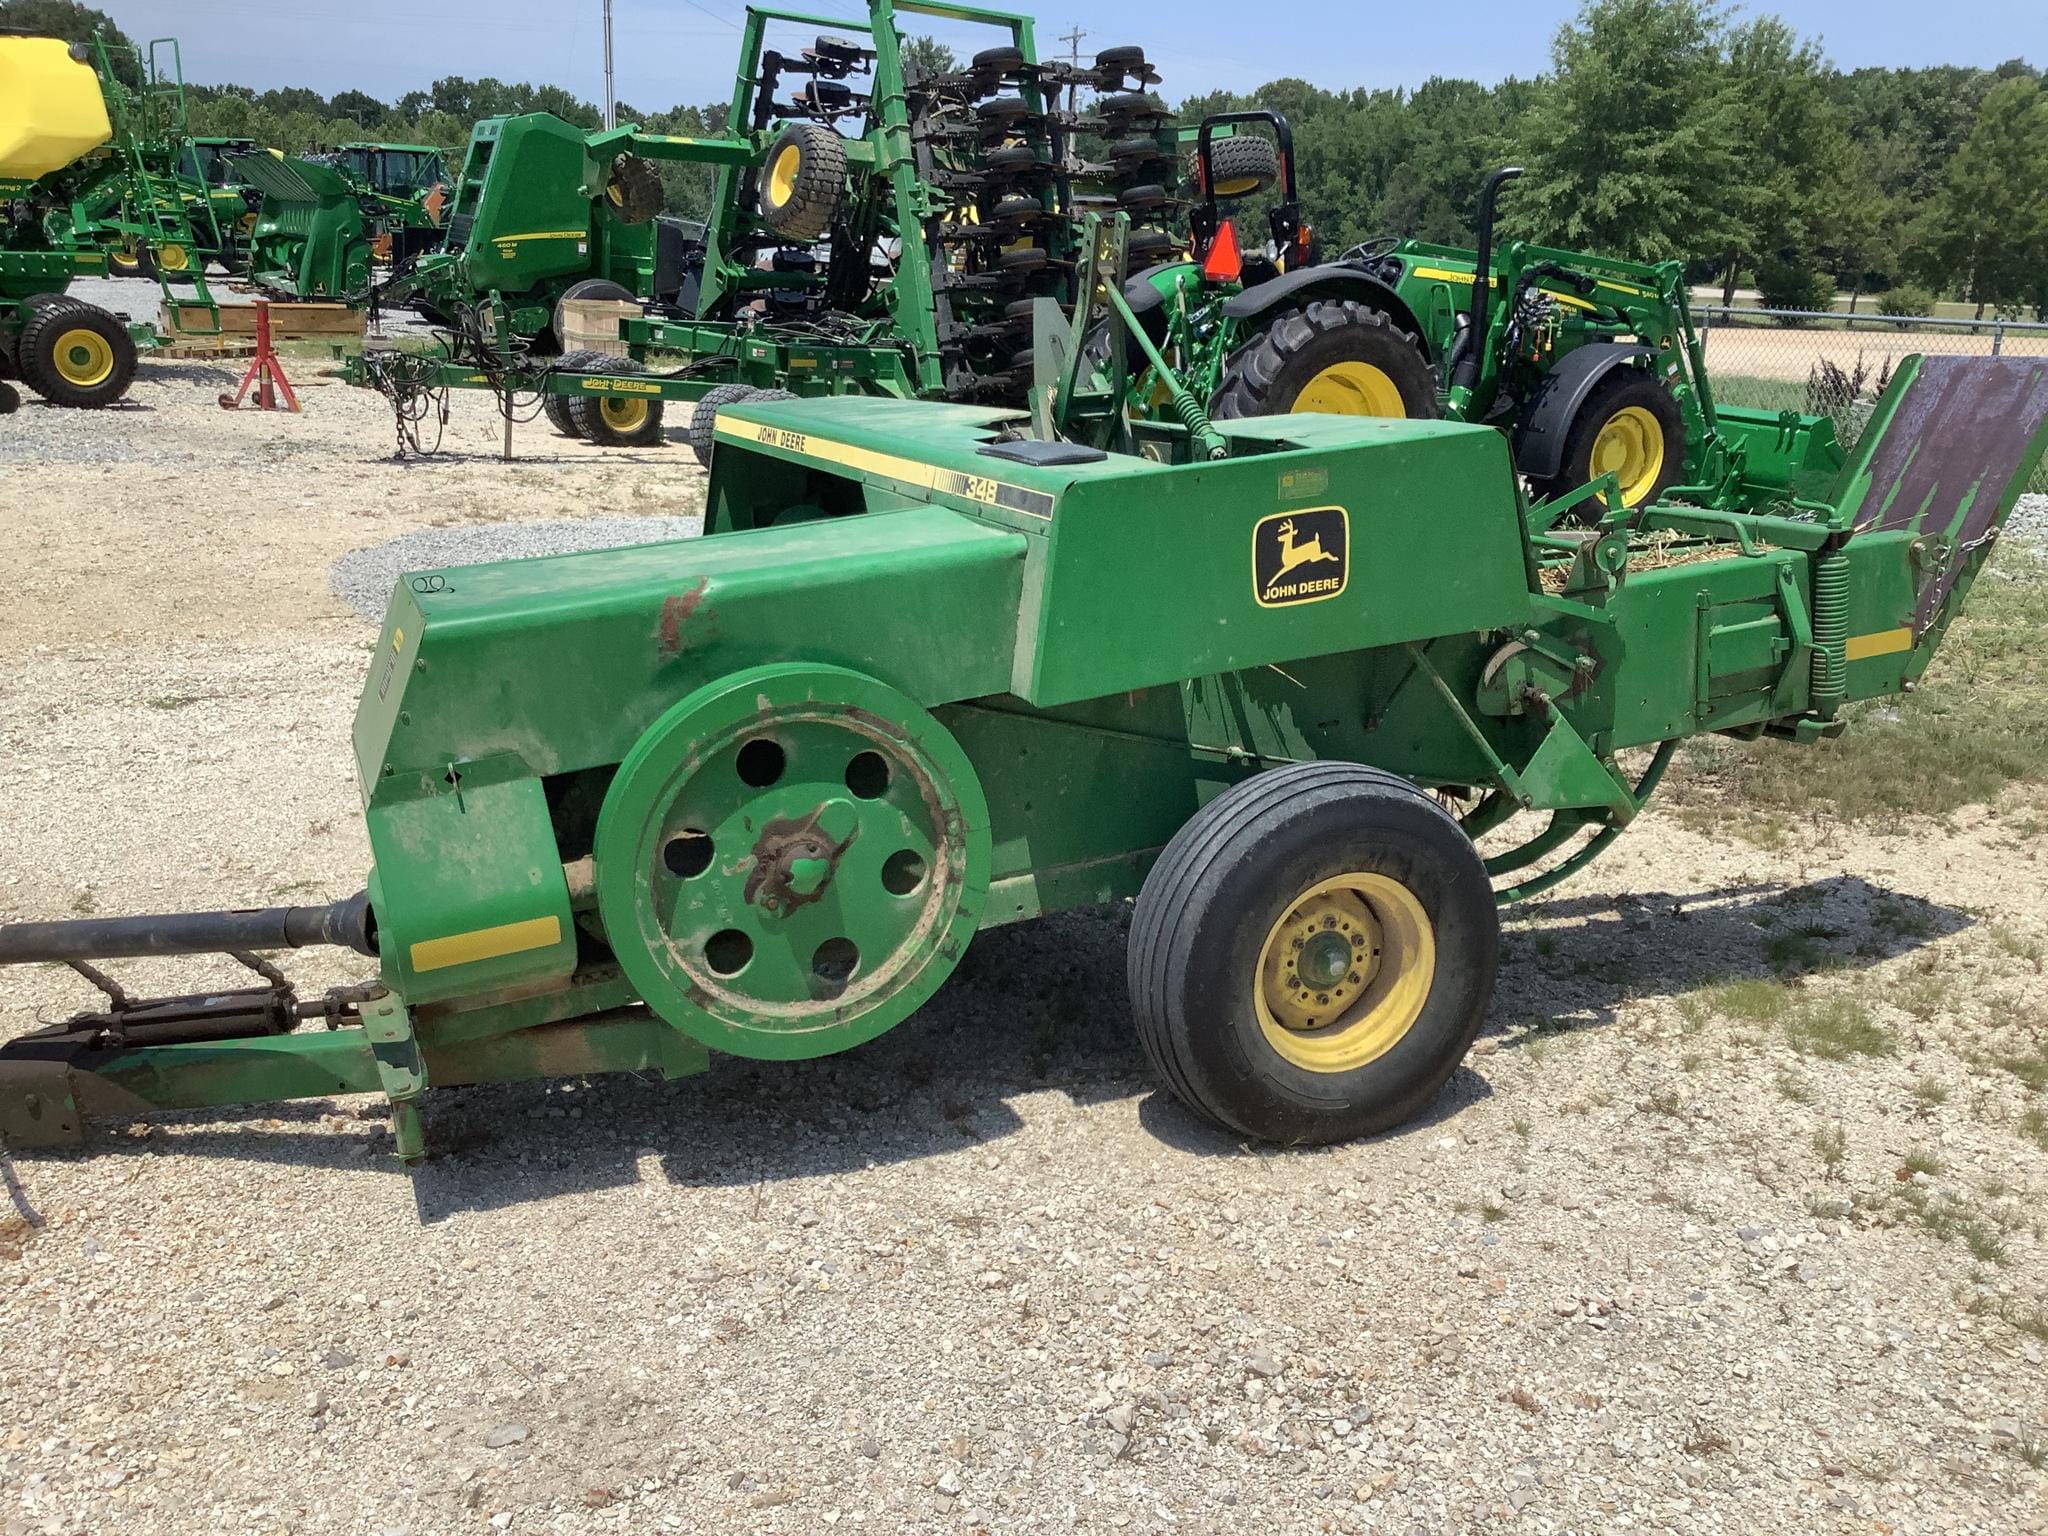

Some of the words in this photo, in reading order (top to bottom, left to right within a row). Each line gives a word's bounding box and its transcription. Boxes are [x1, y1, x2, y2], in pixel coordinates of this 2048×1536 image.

[613, 379, 647, 391] DEERE
[757, 426, 778, 444] JOHN
[780, 431, 806, 452] DEERE
[966, 476, 998, 504] 348
[1263, 584, 1297, 600] JOHN
[1300, 577, 1340, 595] DEERE
